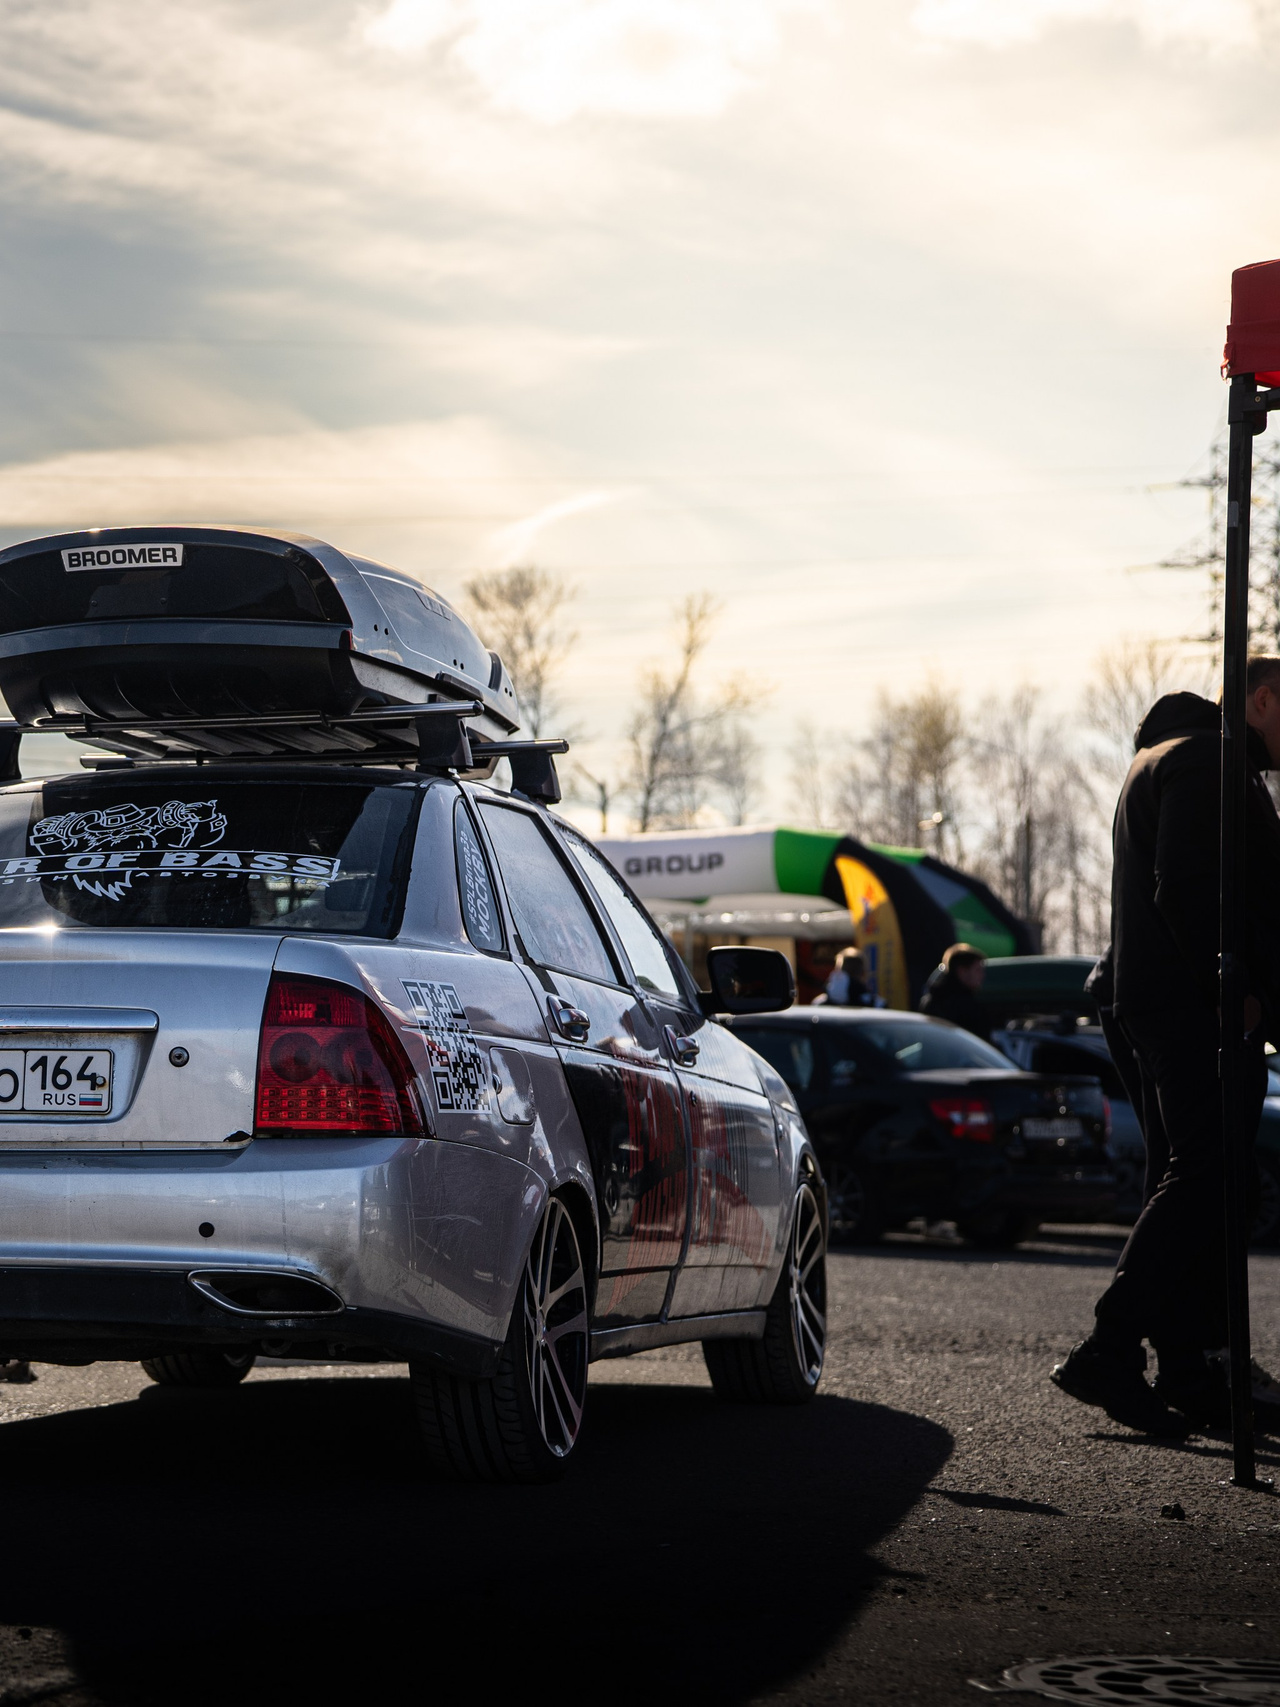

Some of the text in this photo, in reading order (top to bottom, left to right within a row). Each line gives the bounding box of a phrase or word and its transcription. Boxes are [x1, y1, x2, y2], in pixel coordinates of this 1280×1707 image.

[67, 547, 178, 568] BROOMER
[64, 852, 141, 870] OF
[159, 852, 333, 875] BASS
[624, 853, 725, 876] GROUP
[135, 871, 331, 888] АВТОЗВУКА
[469, 839, 491, 942] МОСКВУ
[30, 1055, 98, 1091] 164
[42, 1093, 77, 1106] RUS
